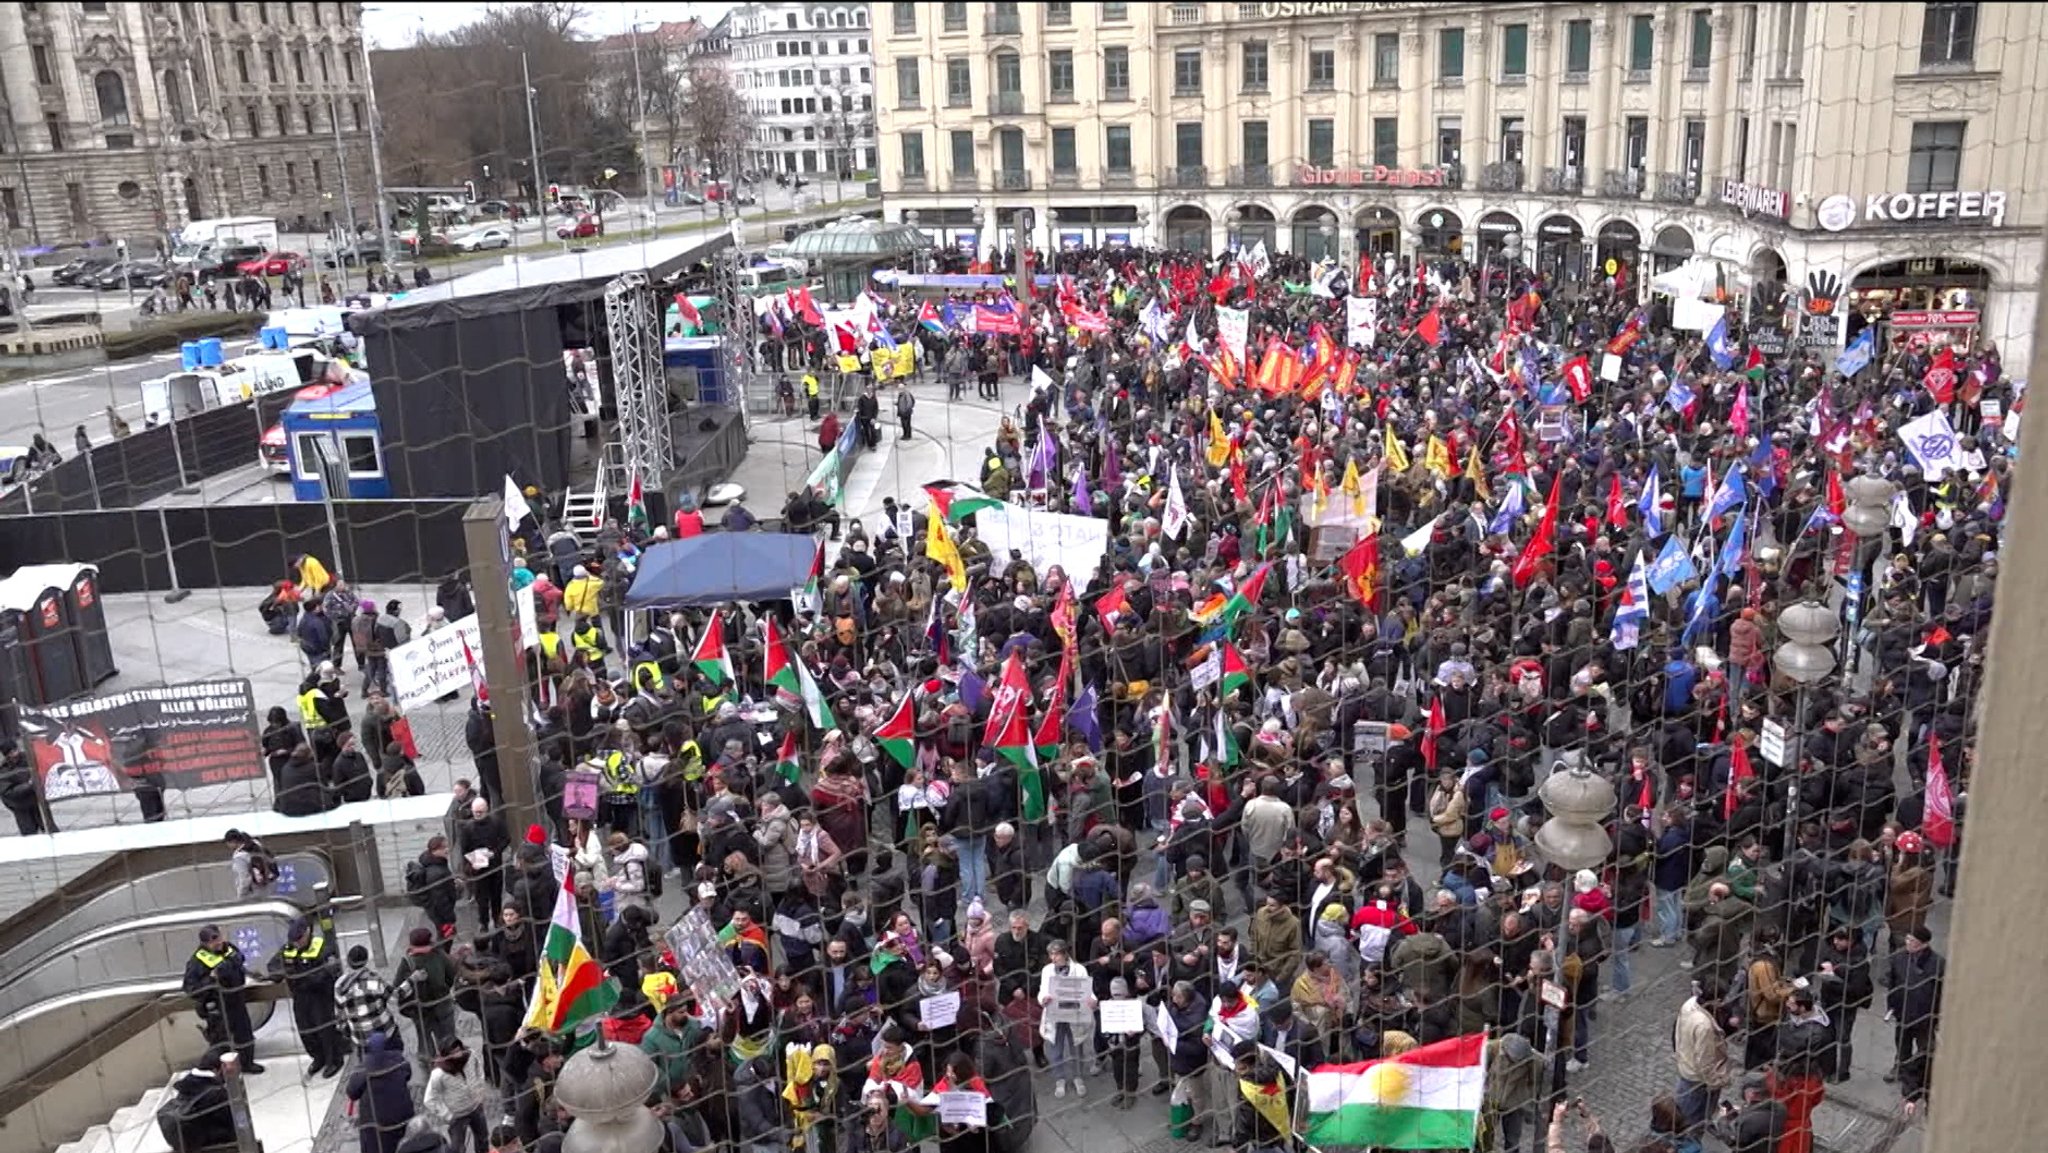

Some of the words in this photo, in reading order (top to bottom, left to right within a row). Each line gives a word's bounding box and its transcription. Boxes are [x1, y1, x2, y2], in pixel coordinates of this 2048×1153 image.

[1261, 2, 1348, 18] OSRAM
[1721, 180, 1783, 217] LEDERWAREN
[1865, 191, 2007, 226] KOFFER
[160, 700, 195, 713] ALLER
